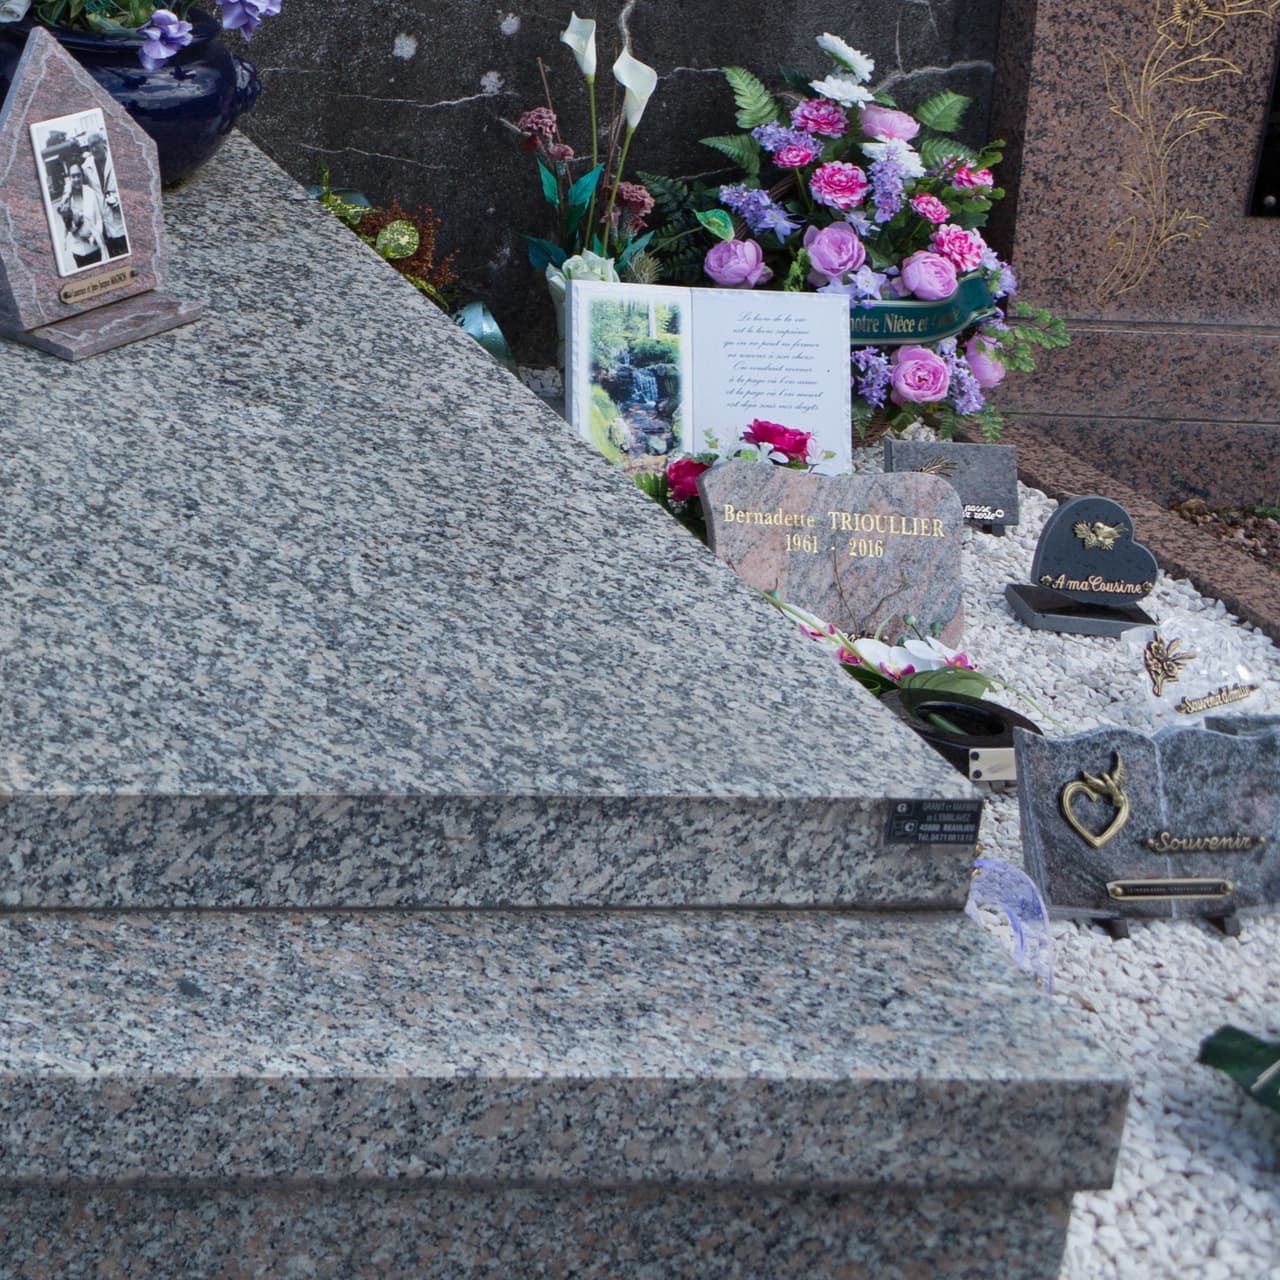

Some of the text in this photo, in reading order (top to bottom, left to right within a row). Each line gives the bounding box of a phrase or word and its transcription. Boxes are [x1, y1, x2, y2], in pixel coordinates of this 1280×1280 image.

[724, 504, 945, 537] Bernadette TRIOULLIER
[785, 534, 818, 553] 1961
[849, 538, 884, 558] 2016
[1052, 574, 1143, 594] A ma Cousine
[1155, 832, 1252, 851] Souvenir
